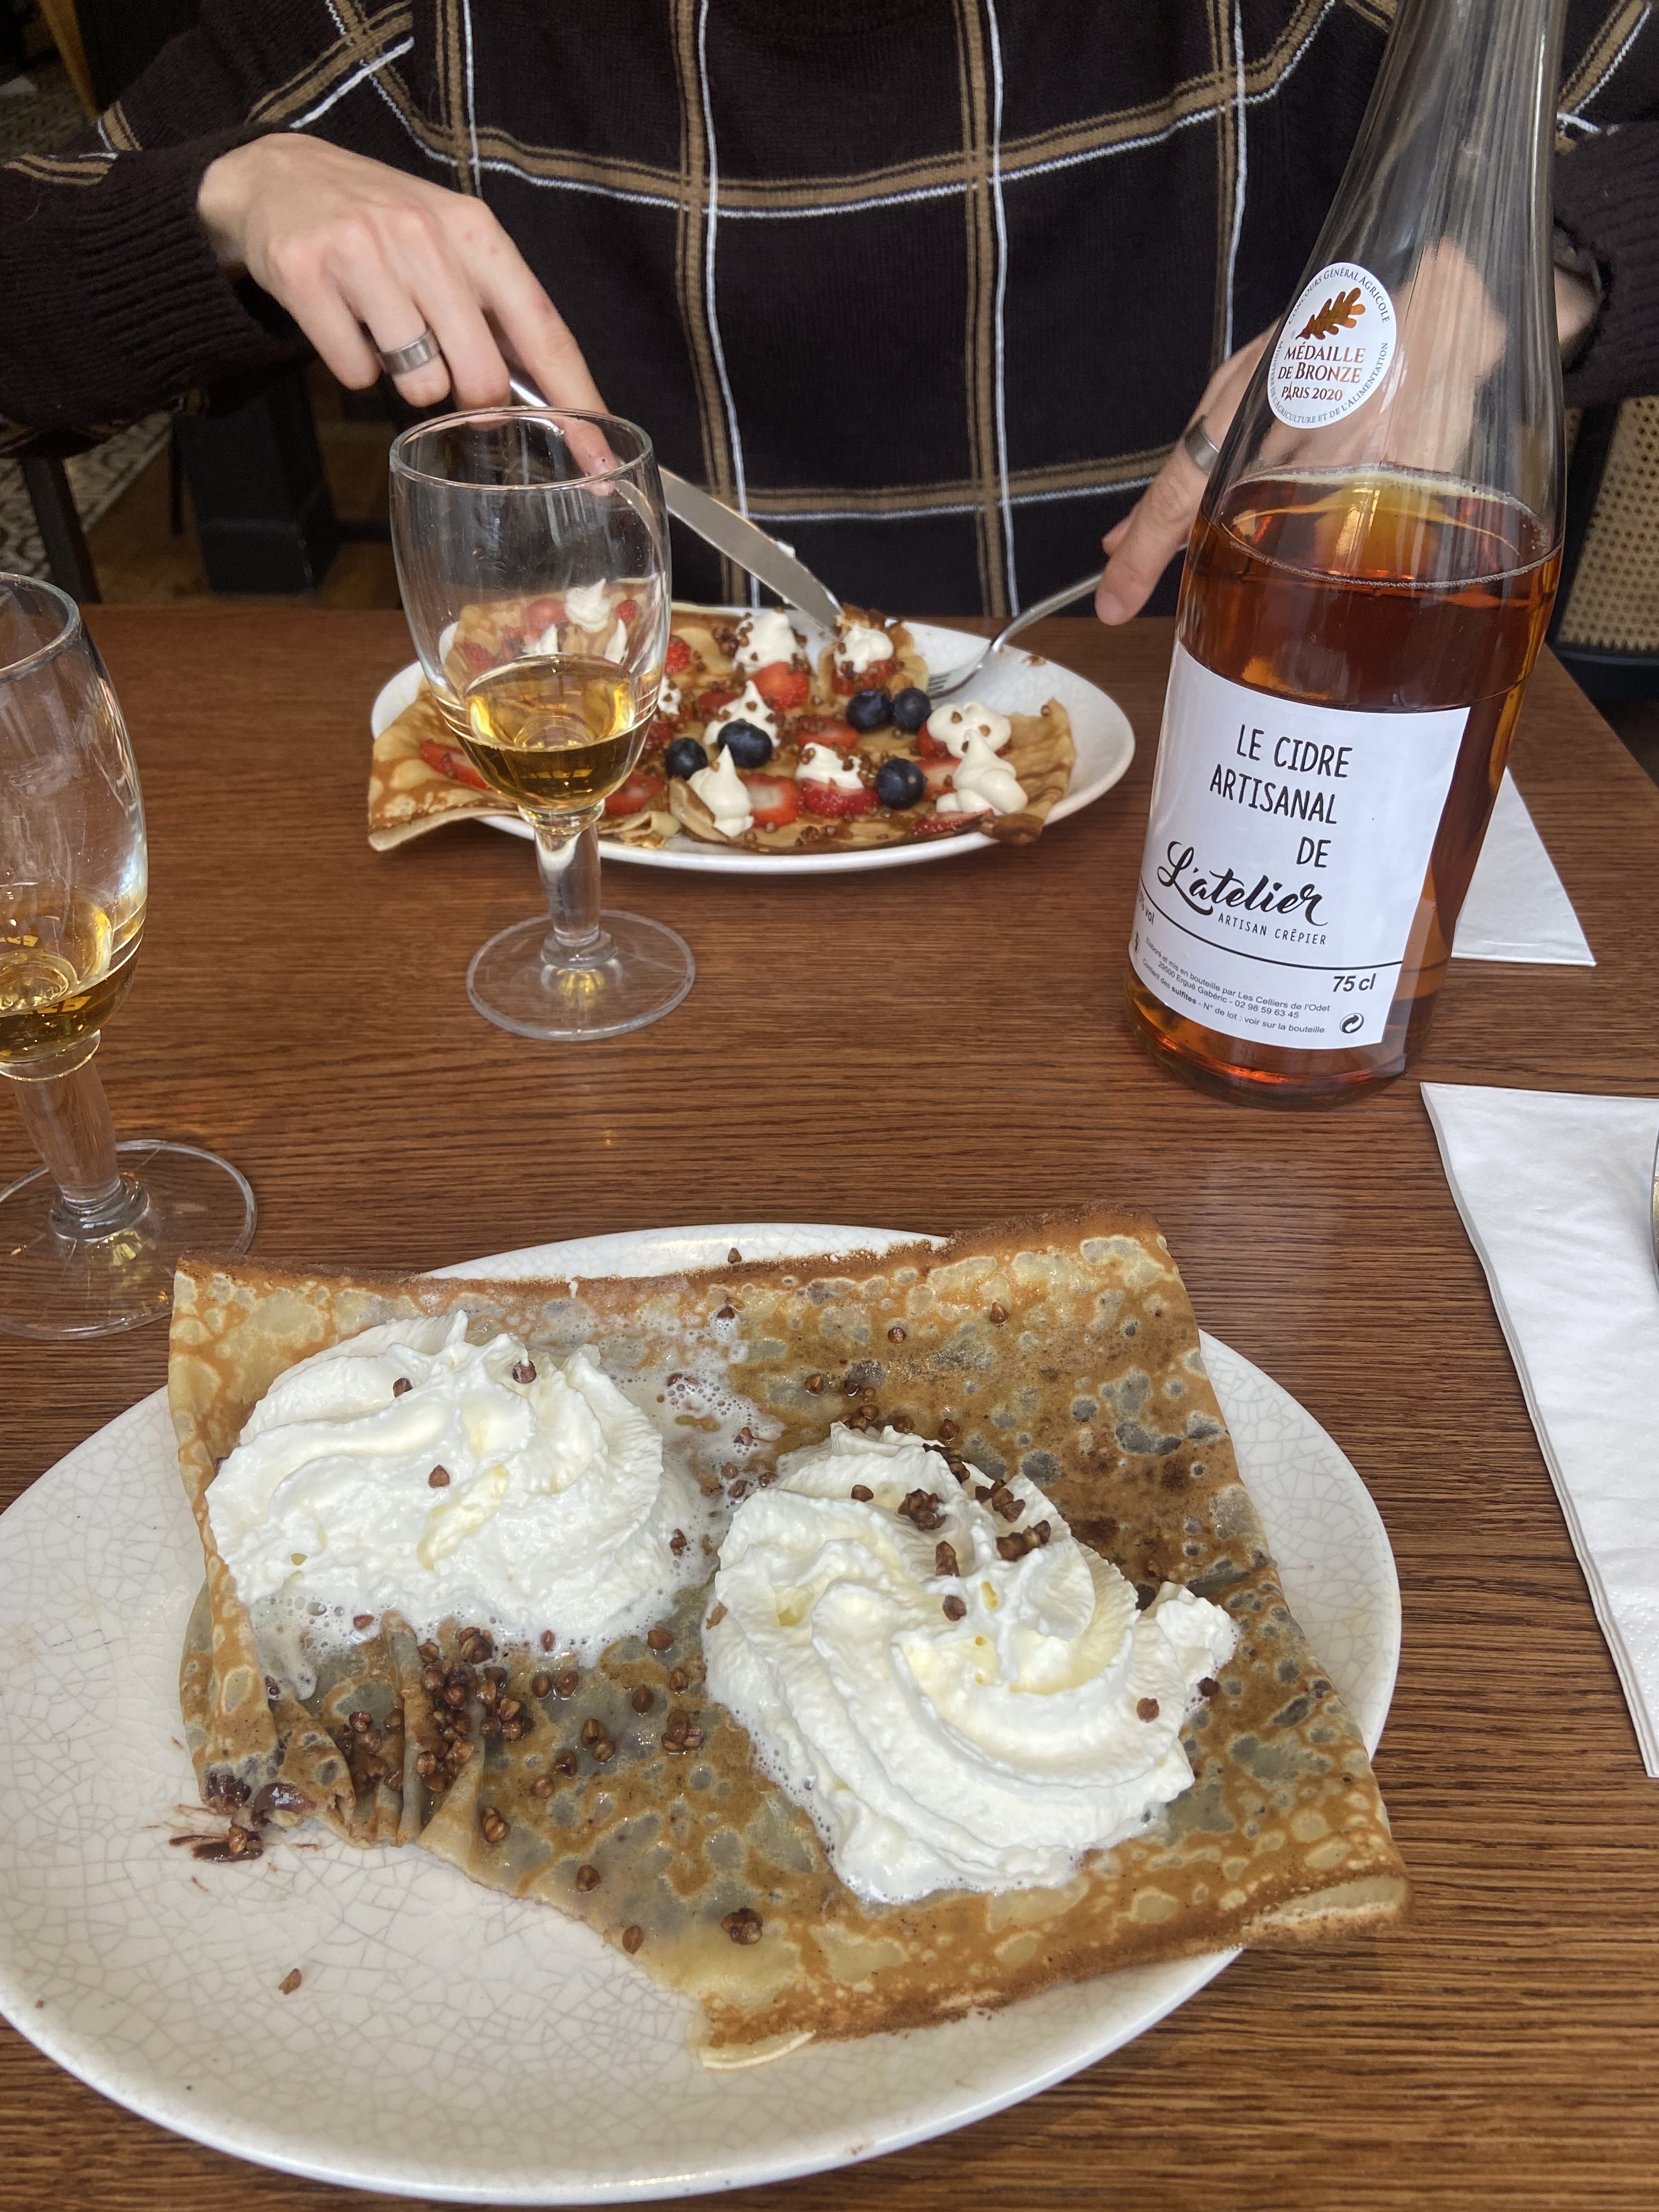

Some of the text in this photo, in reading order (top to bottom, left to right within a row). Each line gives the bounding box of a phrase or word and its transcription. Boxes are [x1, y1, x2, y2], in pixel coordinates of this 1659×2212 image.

[1288, 267, 1390, 324] CONCOURS GÉNÉRAL AGRICOLE
[1277, 362, 1362, 383] DE BRONZE
[1283, 341, 1365, 363] MÉDAILLE
[1281, 381, 1343, 401] PARIS 2020
[1318, 413, 1327, 422] ET
[1329, 408, 1341, 419] DE
[1236, 724, 1353, 778] LE CIDRE
[1209, 764, 1337, 824] ARTISANAL
[1296, 836, 1331, 868] DE
[1156, 840, 1328, 927] L'atelier
[1218, 912, 1327, 945] ARTISAN CRÊPIER
[1158, 961, 1175, 978] 29500
[1176, 974, 1195, 990] Ergué
[1198, 986, 1227, 1003] Gabéric
[1235, 1000, 1245, 1008] 02
[1248, 1003, 1258, 1012] 98
[1261, 1006, 1272, 1014] 59
[1169, 961, 1179, 971] mis
[1180, 968, 1188, 977] en
[1190, 972, 1220, 991] bouteille
[1222, 988, 1236, 996] par
[1238, 991, 1253, 1001] Les
[1256, 996, 1288, 1008] Celliers
[1304, 1003, 1330, 1012] l'Odet
[1333, 973, 1376, 992] 75 cl
[1160, 977, 1170, 989] des
[1171, 986, 1197, 1005] sulfites
[1203, 1002, 1213, 1010] N°
[1215, 1007, 1225, 1015] de
[1227, 1011, 1237, 1020] lot
[1244, 1017, 1260, 1025] voir
[1262, 1020, 1276, 1029] sur
[1289, 1024, 1325, 1034] bouteille
